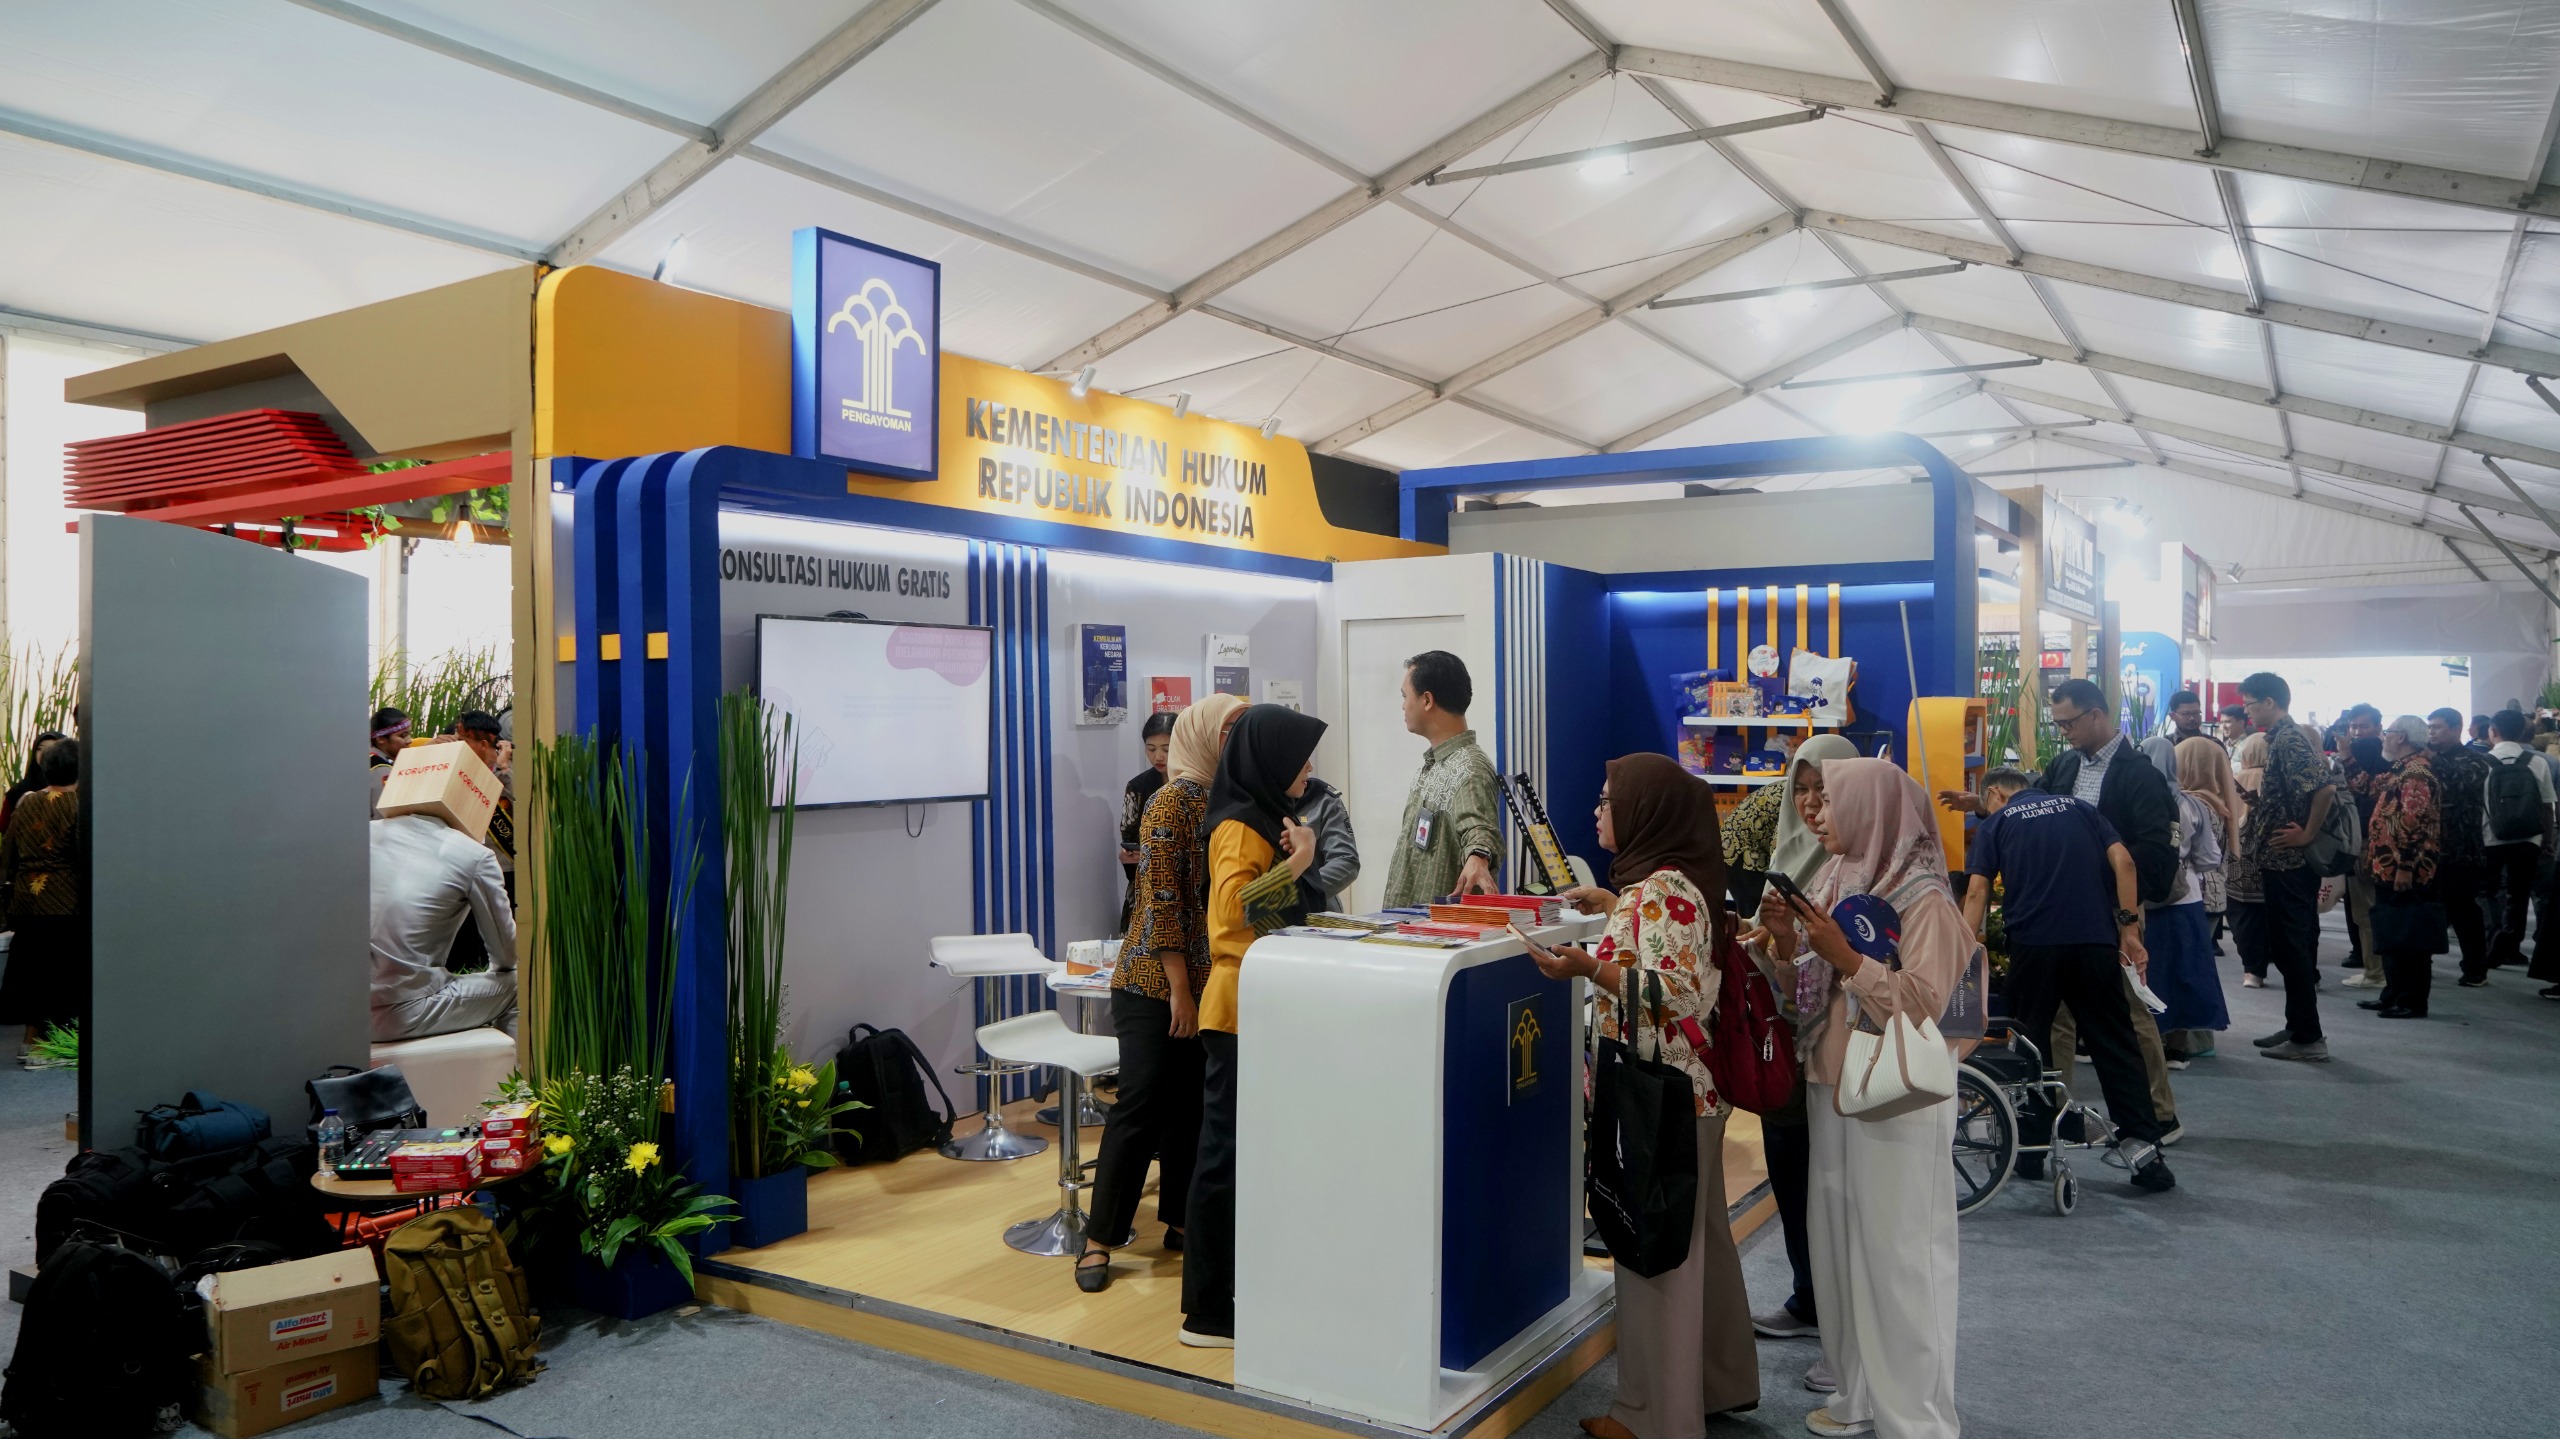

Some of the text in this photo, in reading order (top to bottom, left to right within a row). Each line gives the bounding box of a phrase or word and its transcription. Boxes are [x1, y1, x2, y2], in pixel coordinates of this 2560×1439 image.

[842, 408, 912, 432] PENGAYOMAN
[966, 397, 1267, 496] KEMENTERIAN HUKUM
[979, 457, 1254, 540] REPUBLIK INDONESIA
[719, 548, 950, 599] ONSULTASI HUKUM GRATIS
[1100, 643, 1122, 651] KERUGIAN
[397, 763, 450, 776] KORUPTOR
[458, 769, 491, 808] KORUPTOR
[2003, 797, 2076, 818] GERAKAN ANTI KKN
[2021, 804, 2068, 820] ALUMNI UI
[275, 1311, 327, 1331] Alfamart
[276, 1333, 328, 1351] Air Mineral
[285, 1363, 332, 1386] Mineral Air
[286, 1384, 333, 1408] Alfamart
